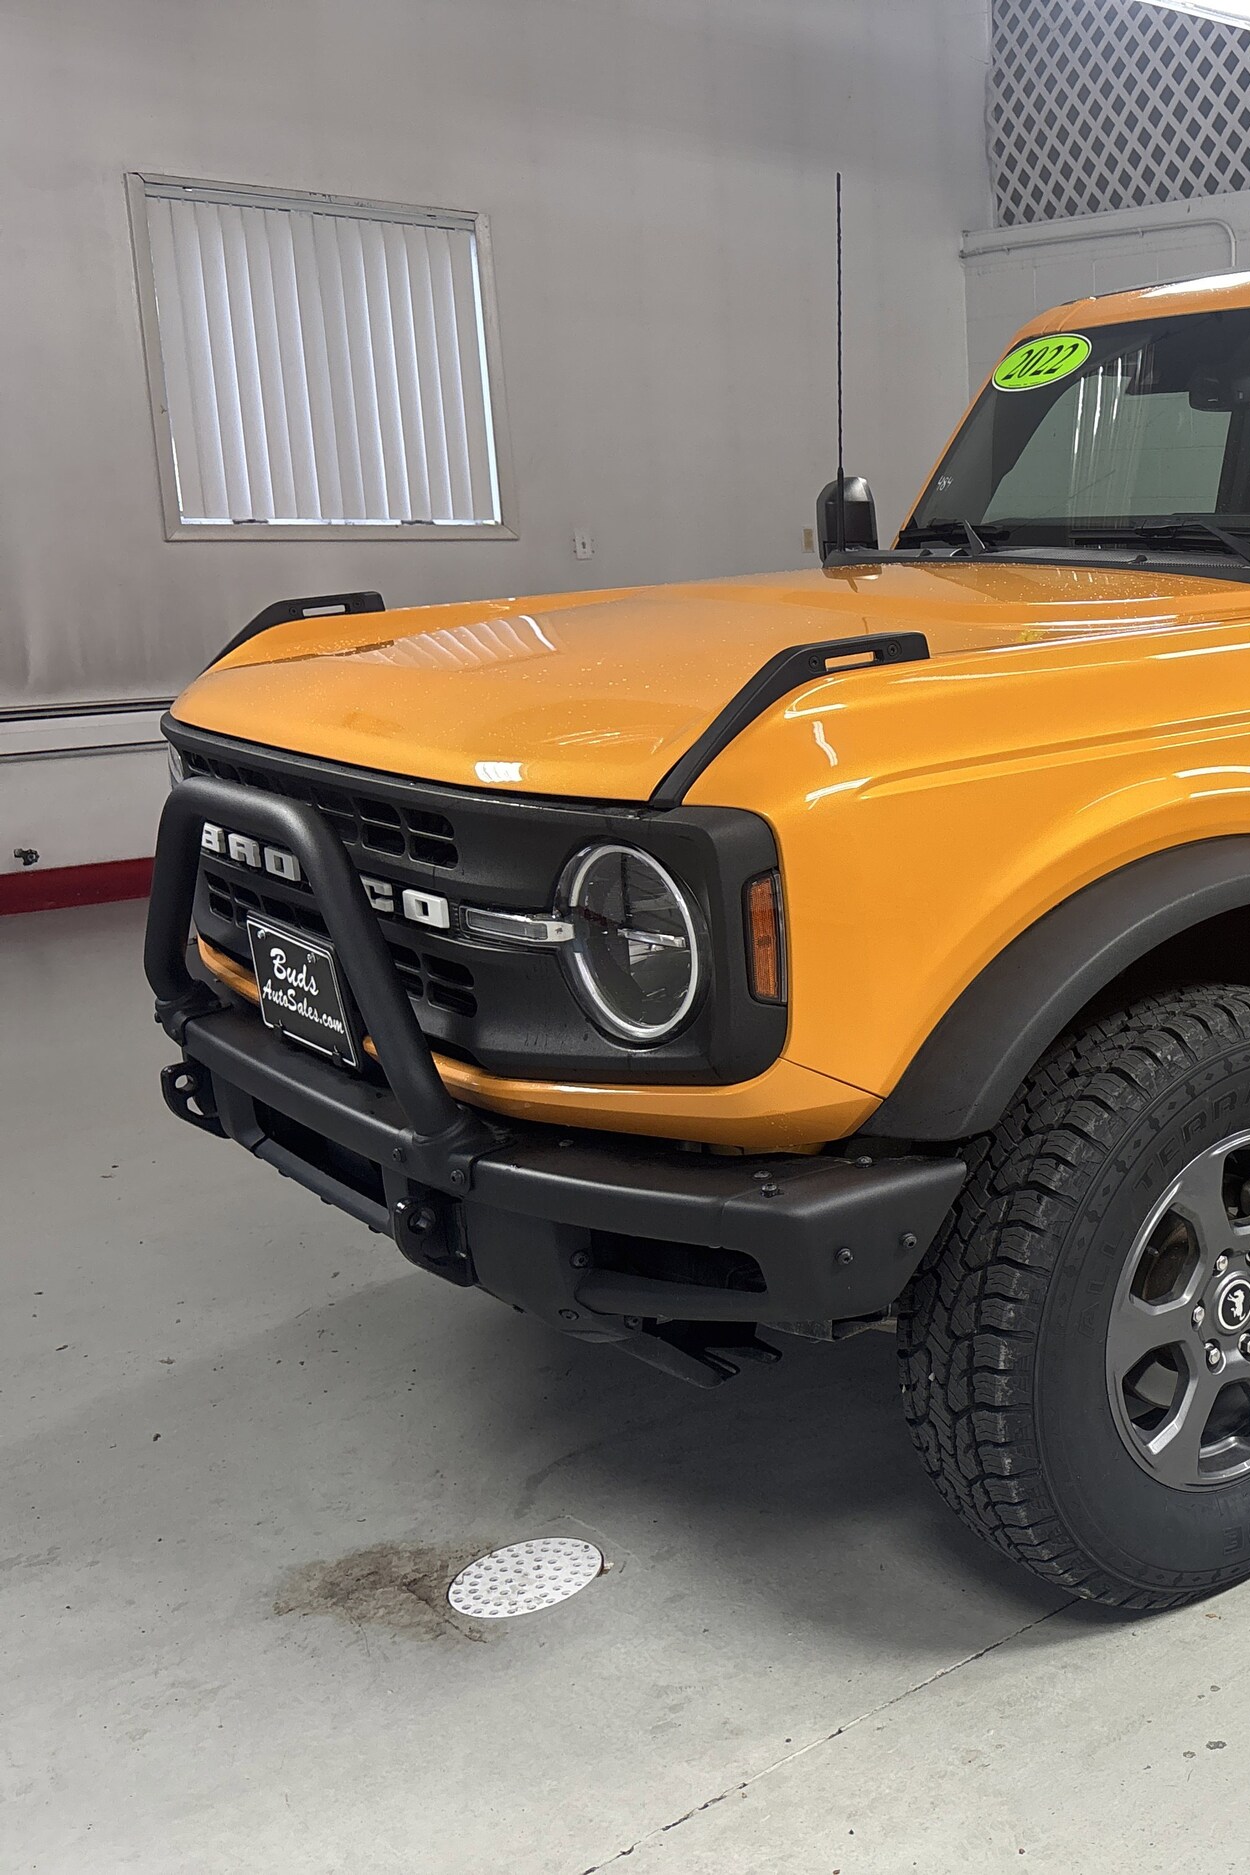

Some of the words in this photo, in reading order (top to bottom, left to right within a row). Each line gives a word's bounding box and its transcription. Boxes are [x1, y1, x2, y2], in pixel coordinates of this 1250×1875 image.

[1001, 342, 1080, 381] 2022
[201, 821, 450, 929] BROCO
[270, 947, 319, 996] Buds
[262, 978, 345, 1035] AutoSales.com
